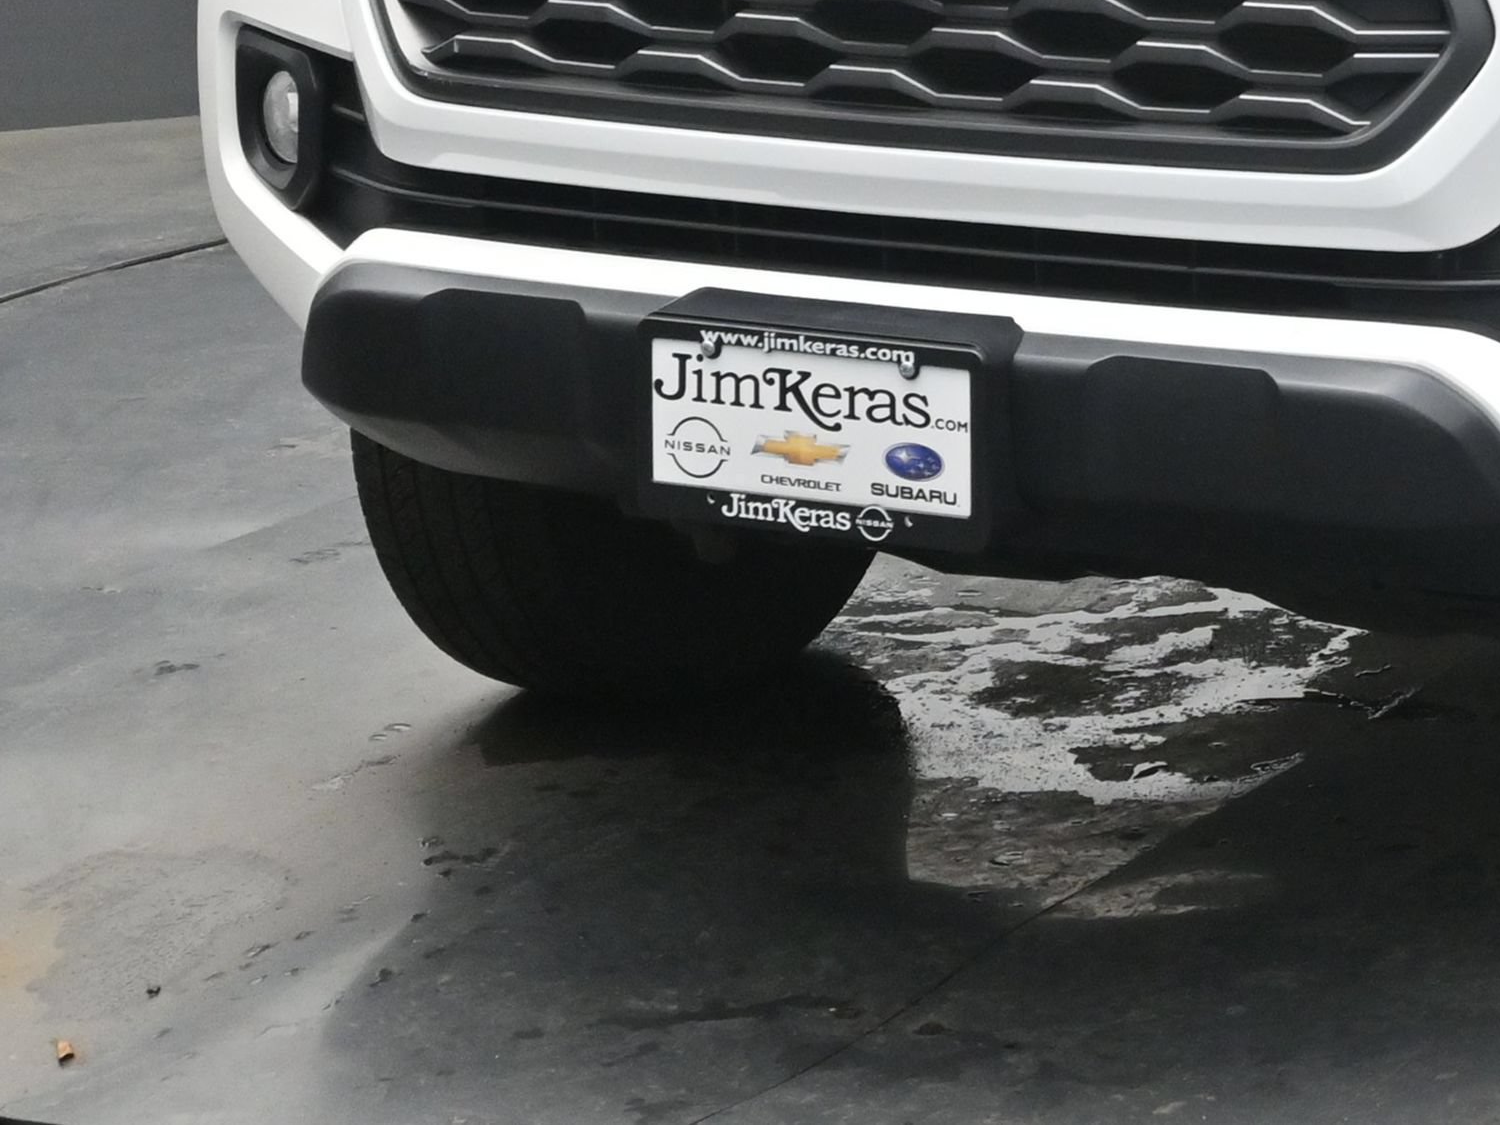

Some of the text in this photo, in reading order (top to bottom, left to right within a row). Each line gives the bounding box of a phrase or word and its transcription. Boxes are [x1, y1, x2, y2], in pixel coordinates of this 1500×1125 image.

[700, 330, 915, 363] www.jimkeras.com
[664, 439, 731, 456] NISSAN
[761, 474, 842, 492] CHEVROLET
[871, 482, 957, 506] SUBARU
